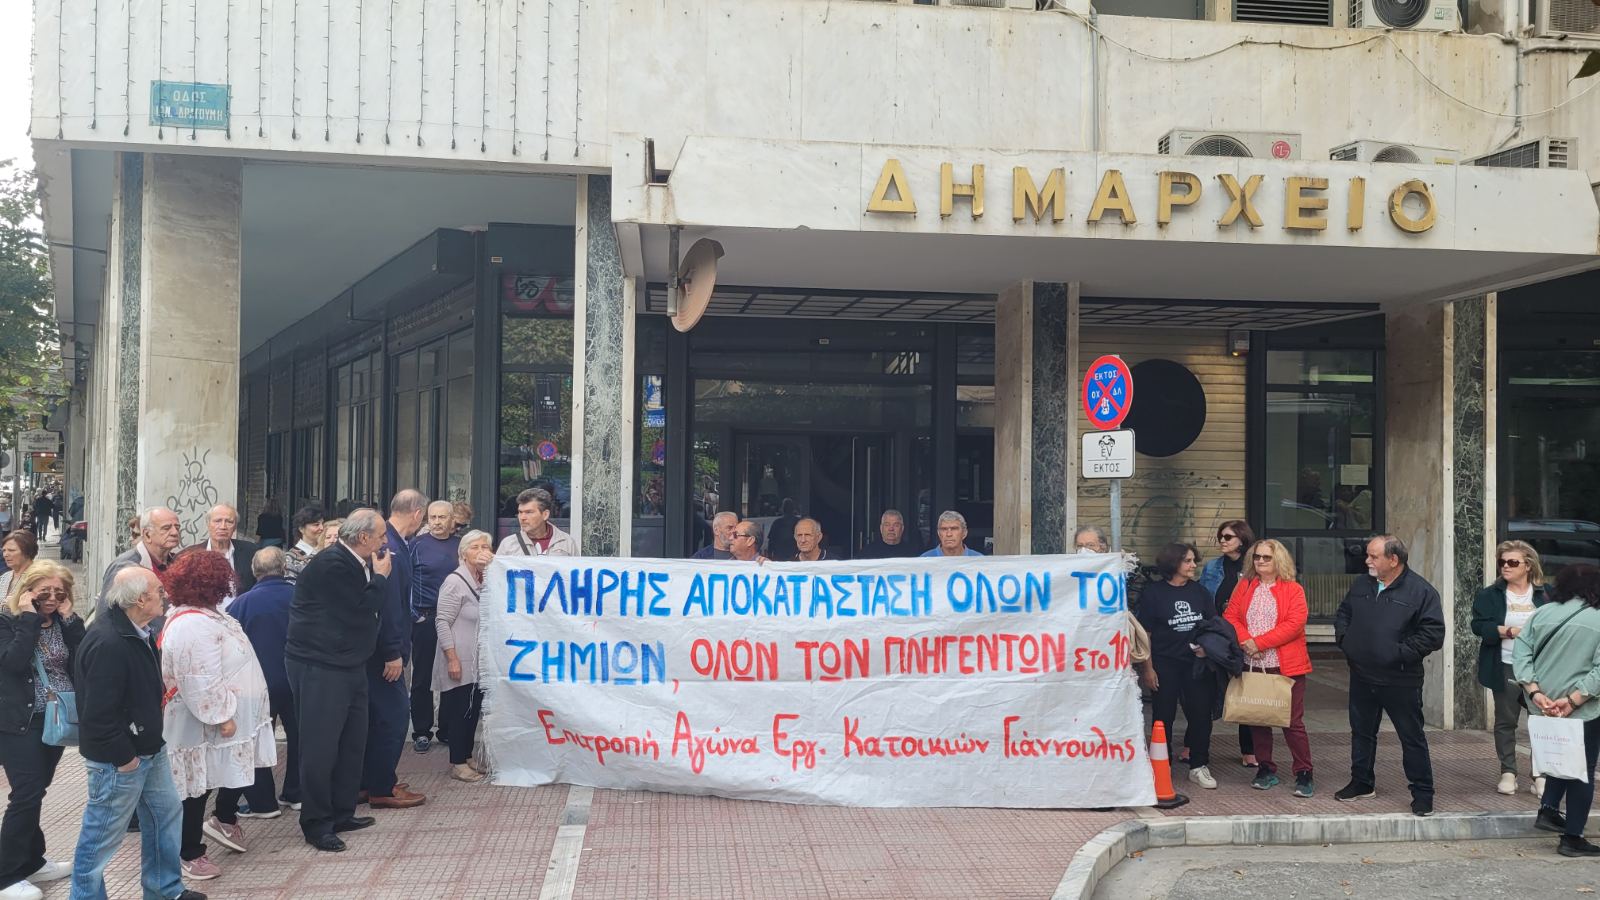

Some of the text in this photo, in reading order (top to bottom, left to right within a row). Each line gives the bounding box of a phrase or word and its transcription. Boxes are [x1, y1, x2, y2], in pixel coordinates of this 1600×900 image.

[173, 90, 207, 103] ΟΔΟΣ
[864, 157, 1438, 234] ΔΗΜΑΡΧΕΙΟ
[1094, 369, 1118, 381] ΕΚΤΟΣ
[1093, 463, 1121, 473] ΕΚΤΟΣ
[1101, 447, 1113, 458] EV
[506, 567, 671, 617] ΠΛΗΡΗΣ
[682, 571, 932, 620] ΑΠΟΚΑΤΑΣΤΑΣΗ
[946, 571, 1052, 613] ΟΛΩΝ
[505, 639, 680, 694] ΖΗΜΙΩΝ,
[690, 637, 779, 681] ΟΛΩΝ
[795, 638, 870, 682] ΤΩΝ
[884, 632, 1066, 675] ΠΛΗΓΕΝΤΩΝ
[537, 709, 1136, 774] Επιτροπή Αγώνα Εργ. Κατοικιών Γιάννουλης
